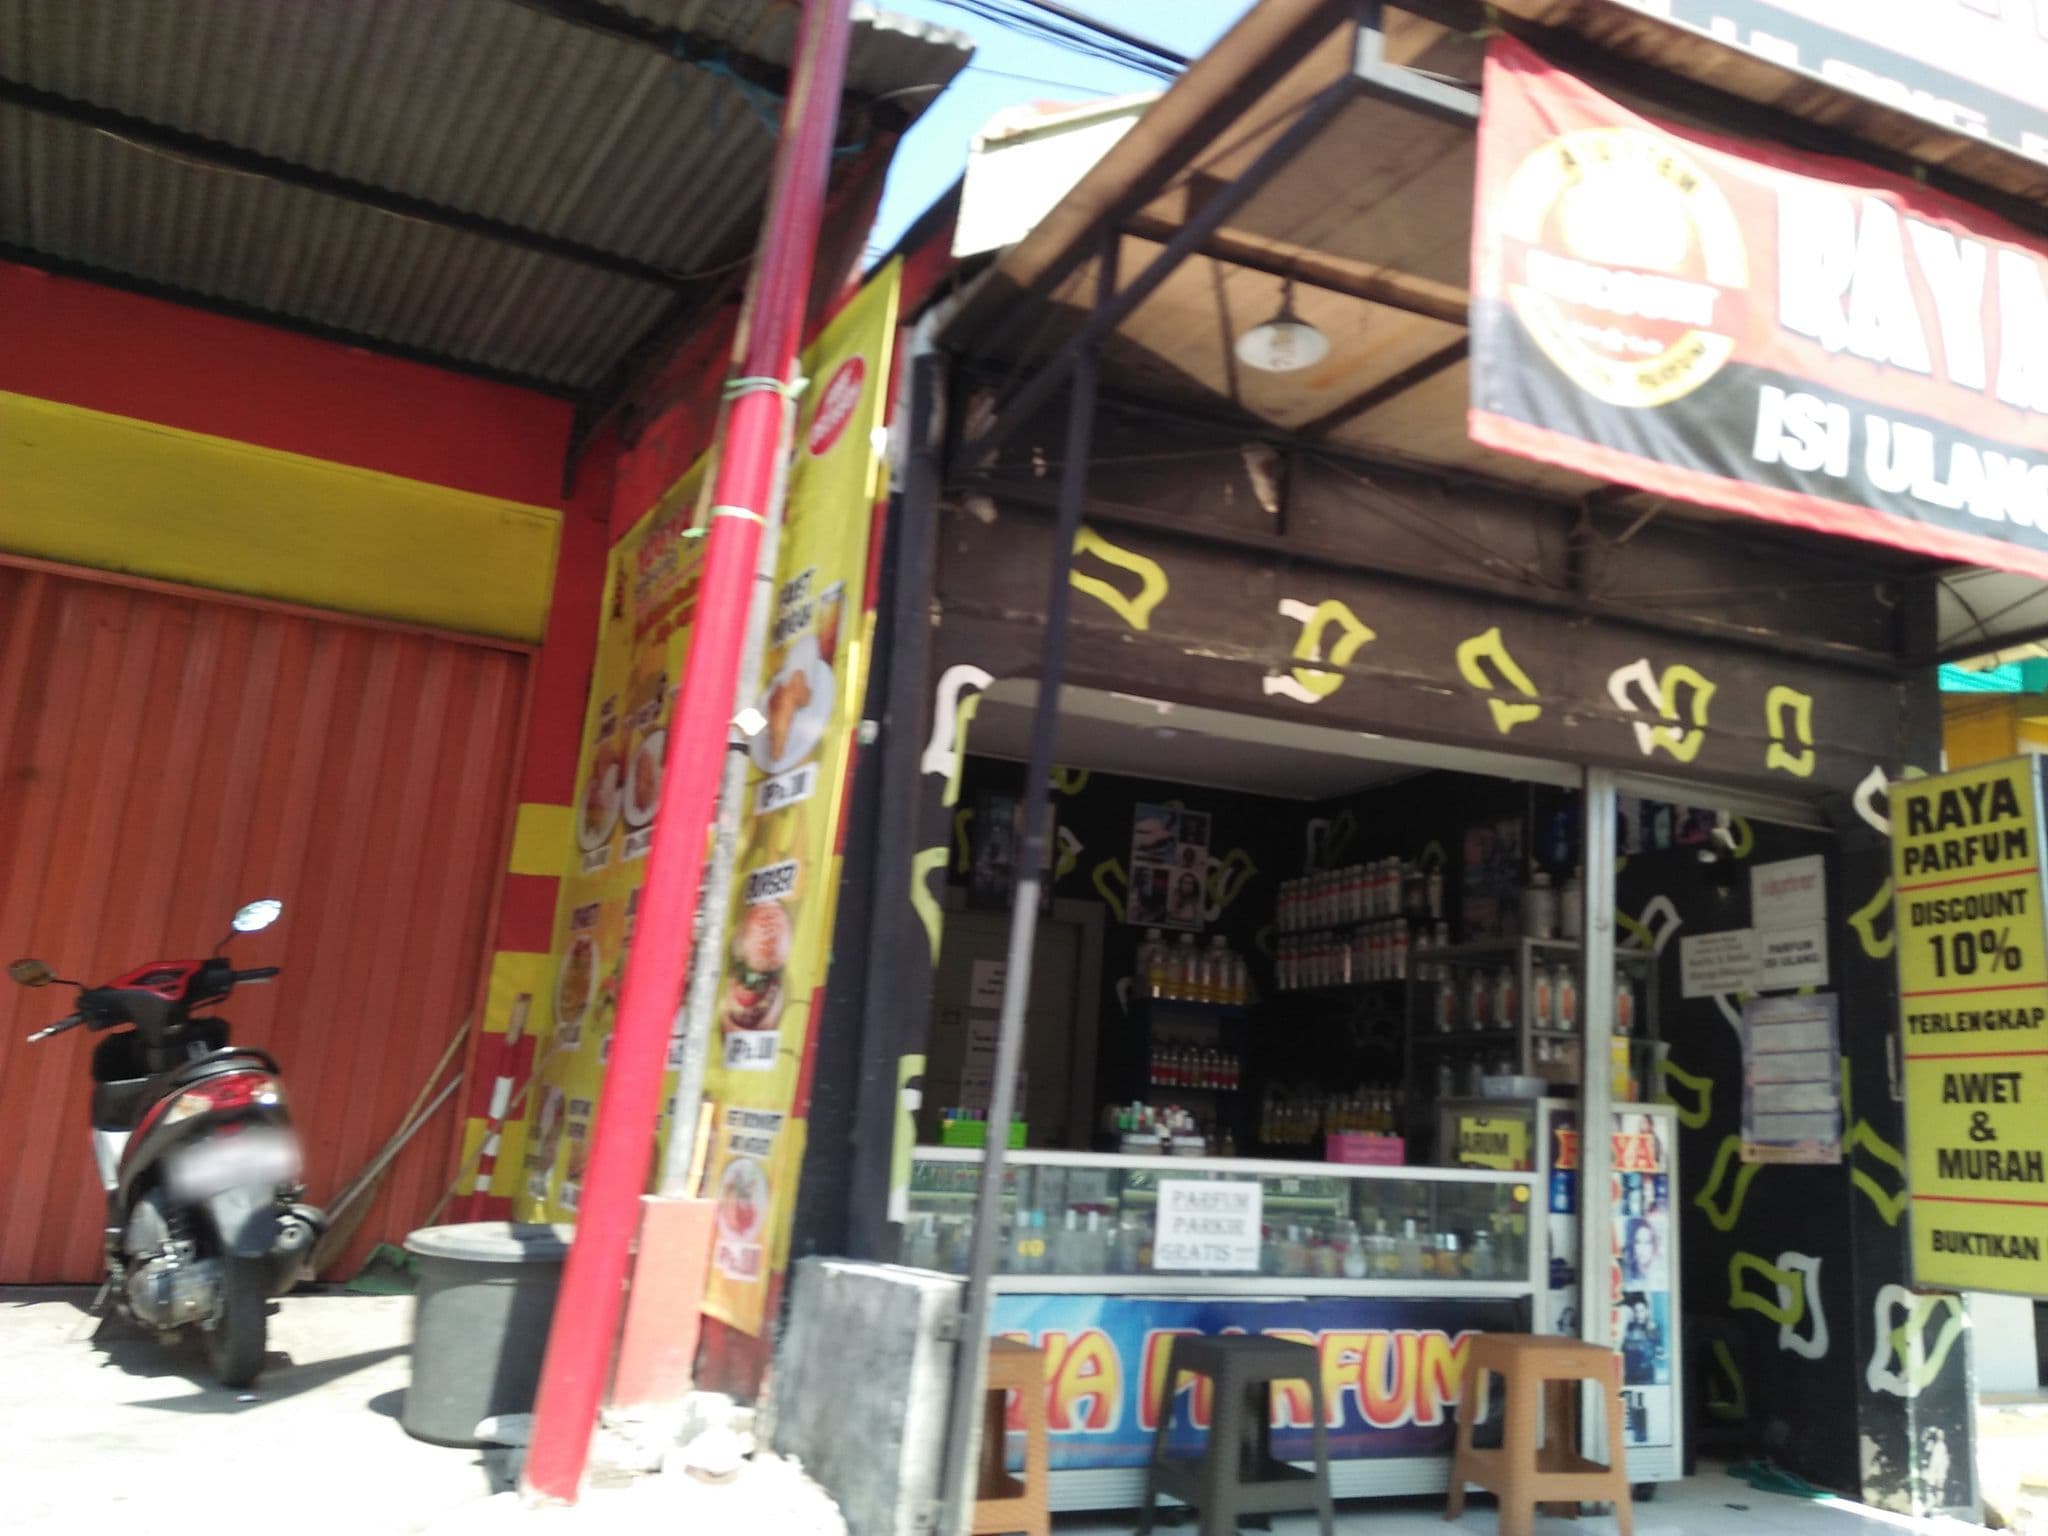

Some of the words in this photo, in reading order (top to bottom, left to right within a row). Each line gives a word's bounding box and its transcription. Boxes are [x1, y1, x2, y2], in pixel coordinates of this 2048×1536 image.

[1752, 384, 1850, 478] ISI
[1907, 778, 2020, 836] RAYA
[1904, 827, 2028, 876] PARFUM
[1911, 888, 2026, 927] DISCOUNT
[1928, 927, 2022, 977] 10%
[1906, 1007, 2045, 1034] TERLENGKAP
[1943, 1072, 2021, 1104] AWET
[1969, 1111, 1997, 1142] &
[1937, 1149, 2044, 1183] MURAH
[1932, 1229, 2039, 1261] BUKTIKAN
